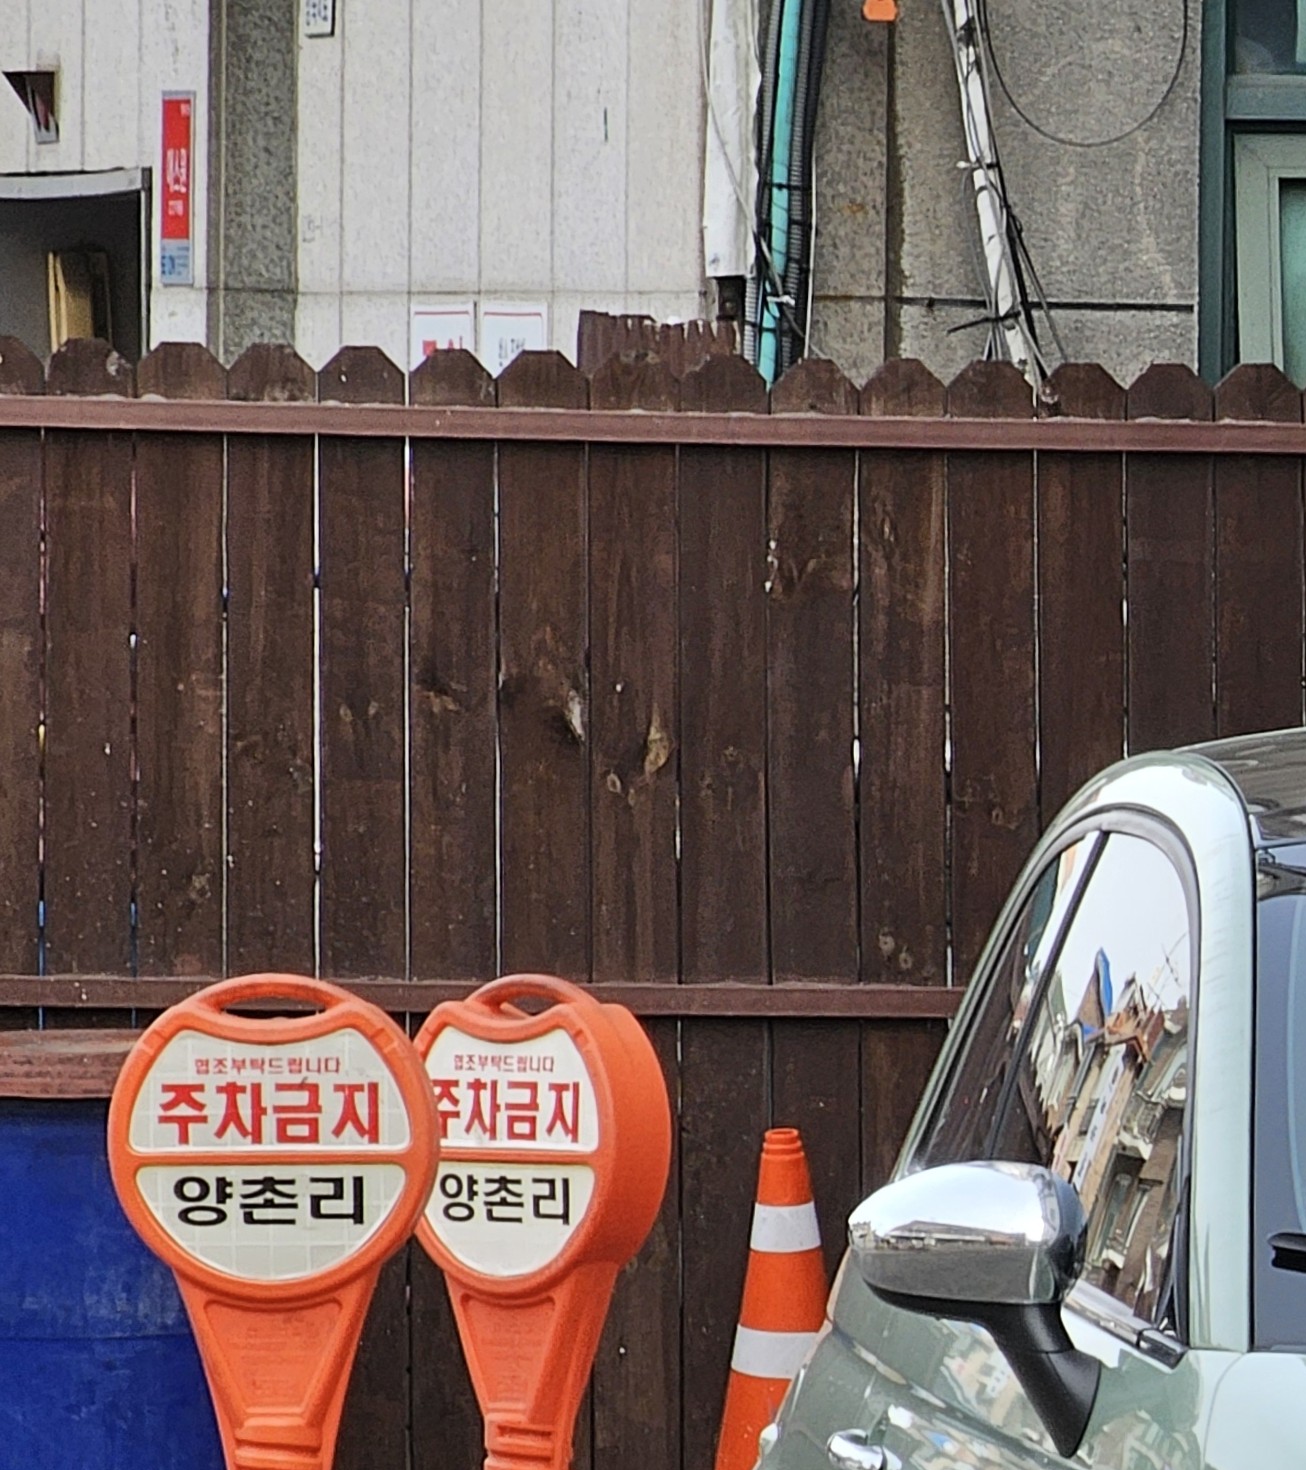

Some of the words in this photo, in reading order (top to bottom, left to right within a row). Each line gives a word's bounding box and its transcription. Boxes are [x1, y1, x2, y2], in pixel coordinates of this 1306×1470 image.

[157, 1081, 381, 1145] 주차금지
[432, 1078, 580, 1143] 주차금지
[172, 1175, 366, 1227] 양촌리
[440, 1172, 571, 1226] 양촌리
